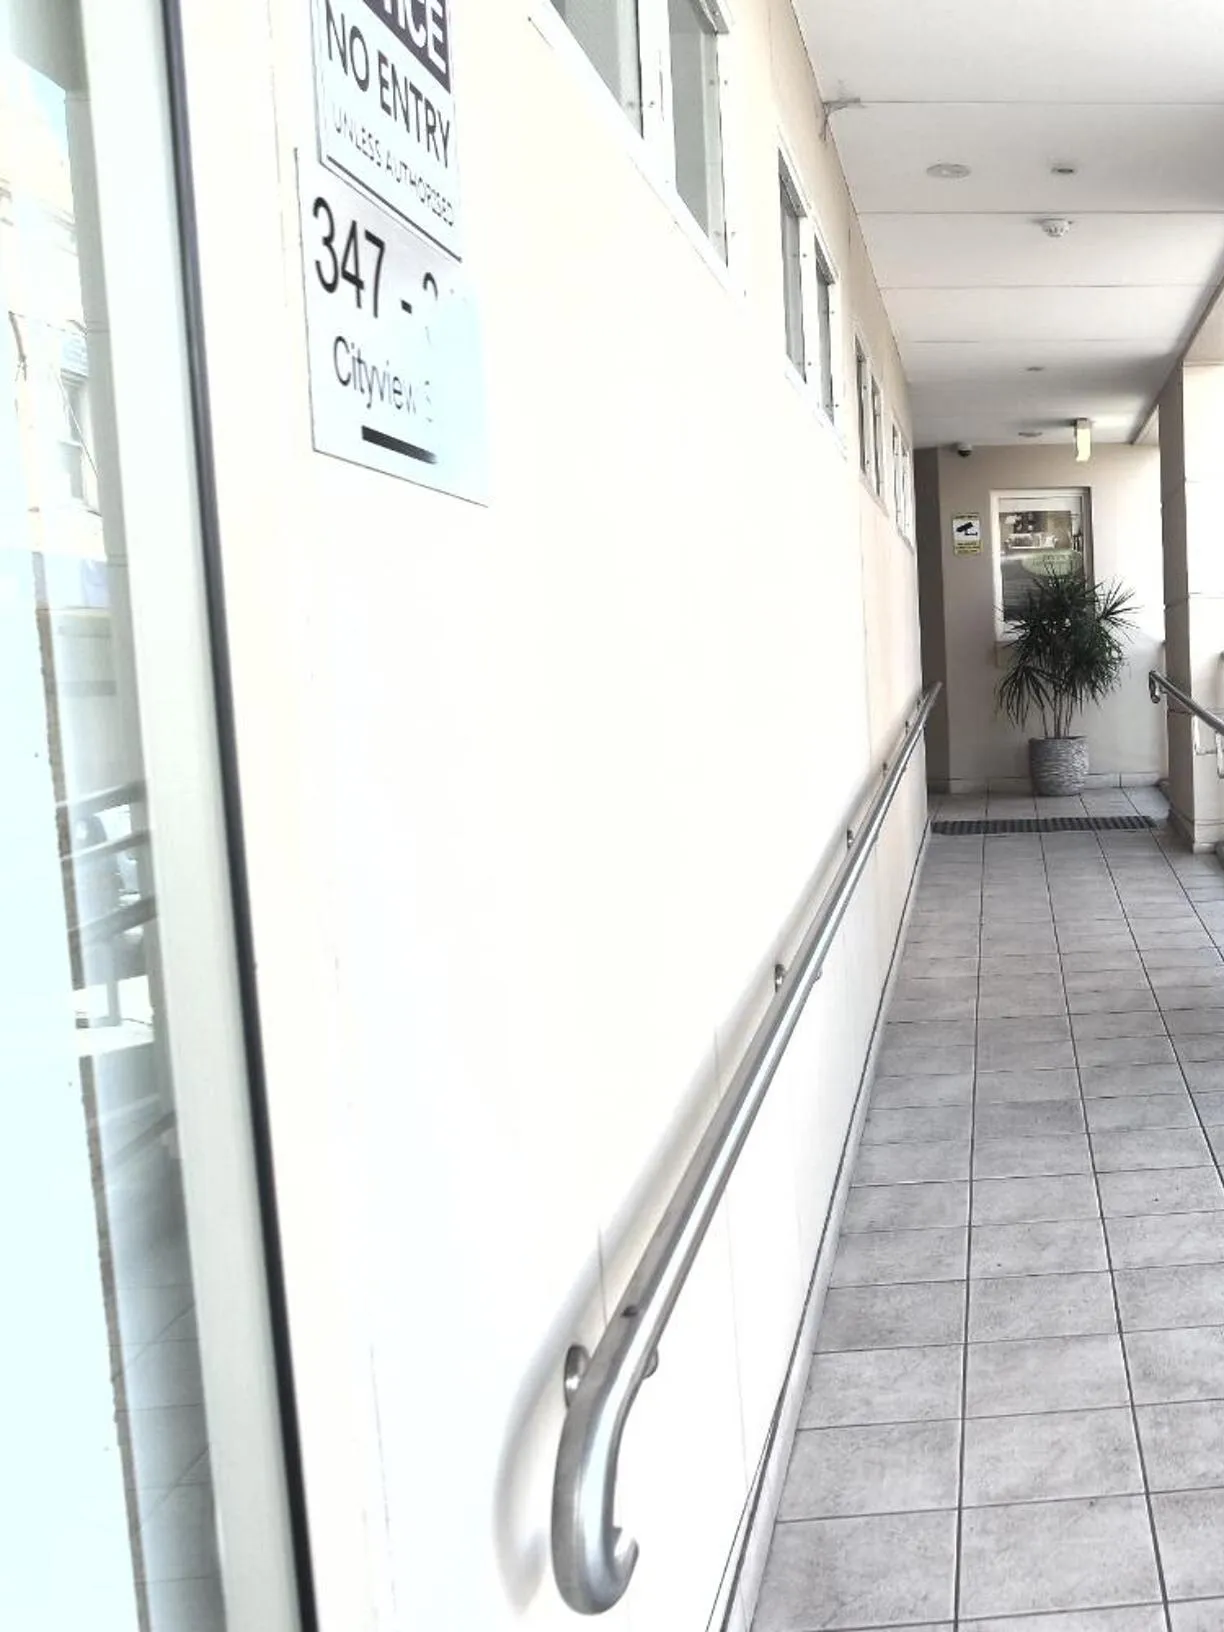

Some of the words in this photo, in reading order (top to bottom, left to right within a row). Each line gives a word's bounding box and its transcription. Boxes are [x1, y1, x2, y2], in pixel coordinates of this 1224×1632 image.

[325, 0, 371, 92] NO
[377, 49, 450, 169] ENTRY
[312, 196, 386, 319] 347
